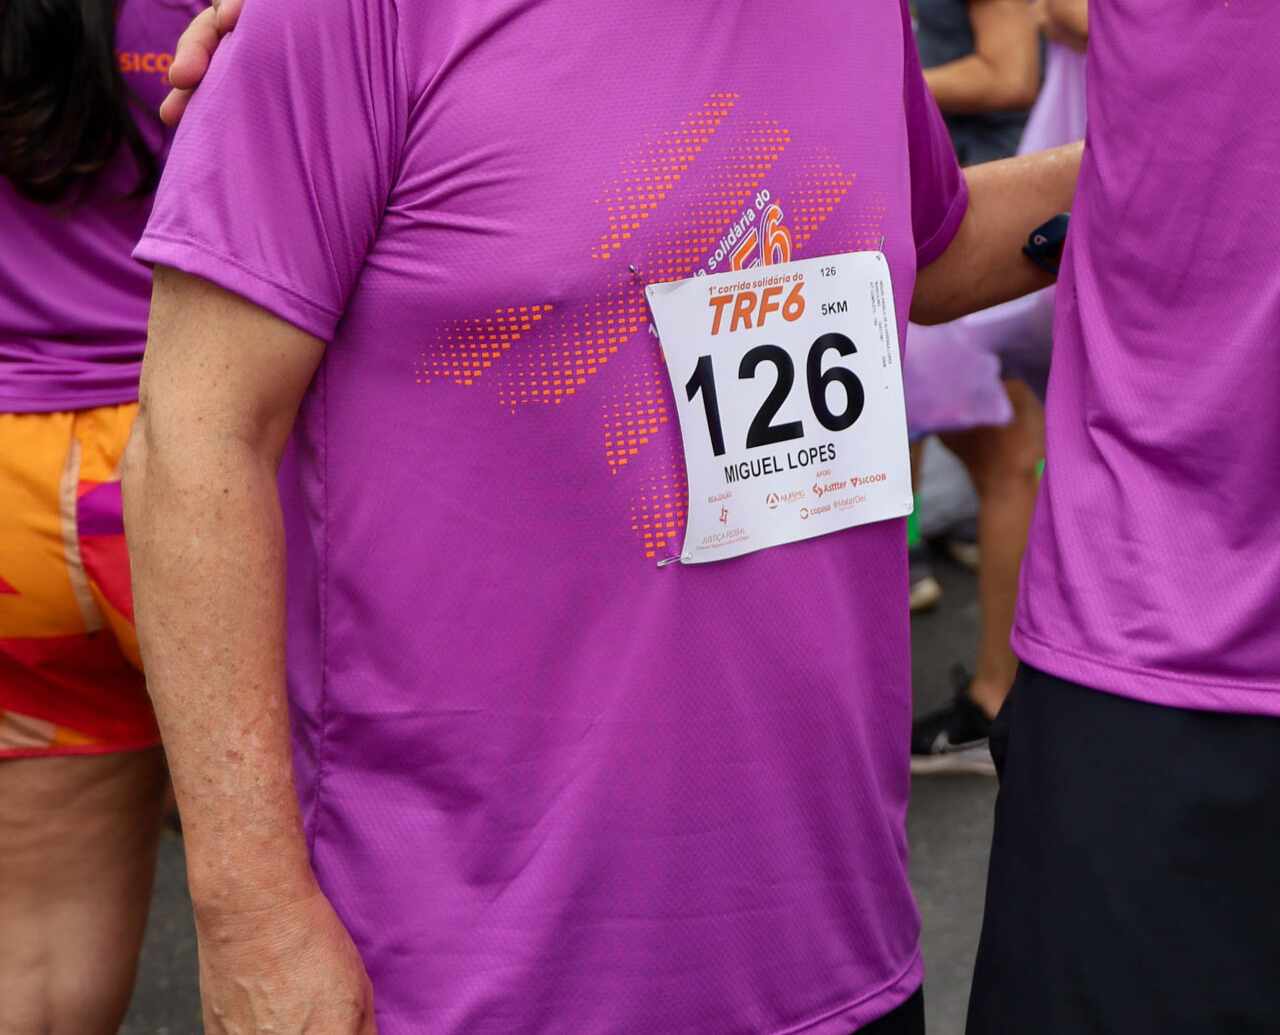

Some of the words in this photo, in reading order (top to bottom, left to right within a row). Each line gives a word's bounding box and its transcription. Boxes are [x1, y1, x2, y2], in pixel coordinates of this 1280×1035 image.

[118, 52, 175, 73] SICO
[707, 208, 756, 270] solidária
[755, 189, 771, 210] do
[820, 266, 837, 277] 126
[718, 280, 751, 294] corrida
[752, 275, 791, 289] solidária
[792, 272, 804, 282] do
[708, 282, 805, 336] TRF6
[821, 300, 848, 316] 5KM
[685, 332, 865, 457] 126
[724, 455, 784, 484] MIGUEL
[787, 443, 837, 470] LOPES
[824, 481, 847, 493] Asttter
[858, 473, 887, 486] SICOOB
[810, 505, 832, 516] copasa
